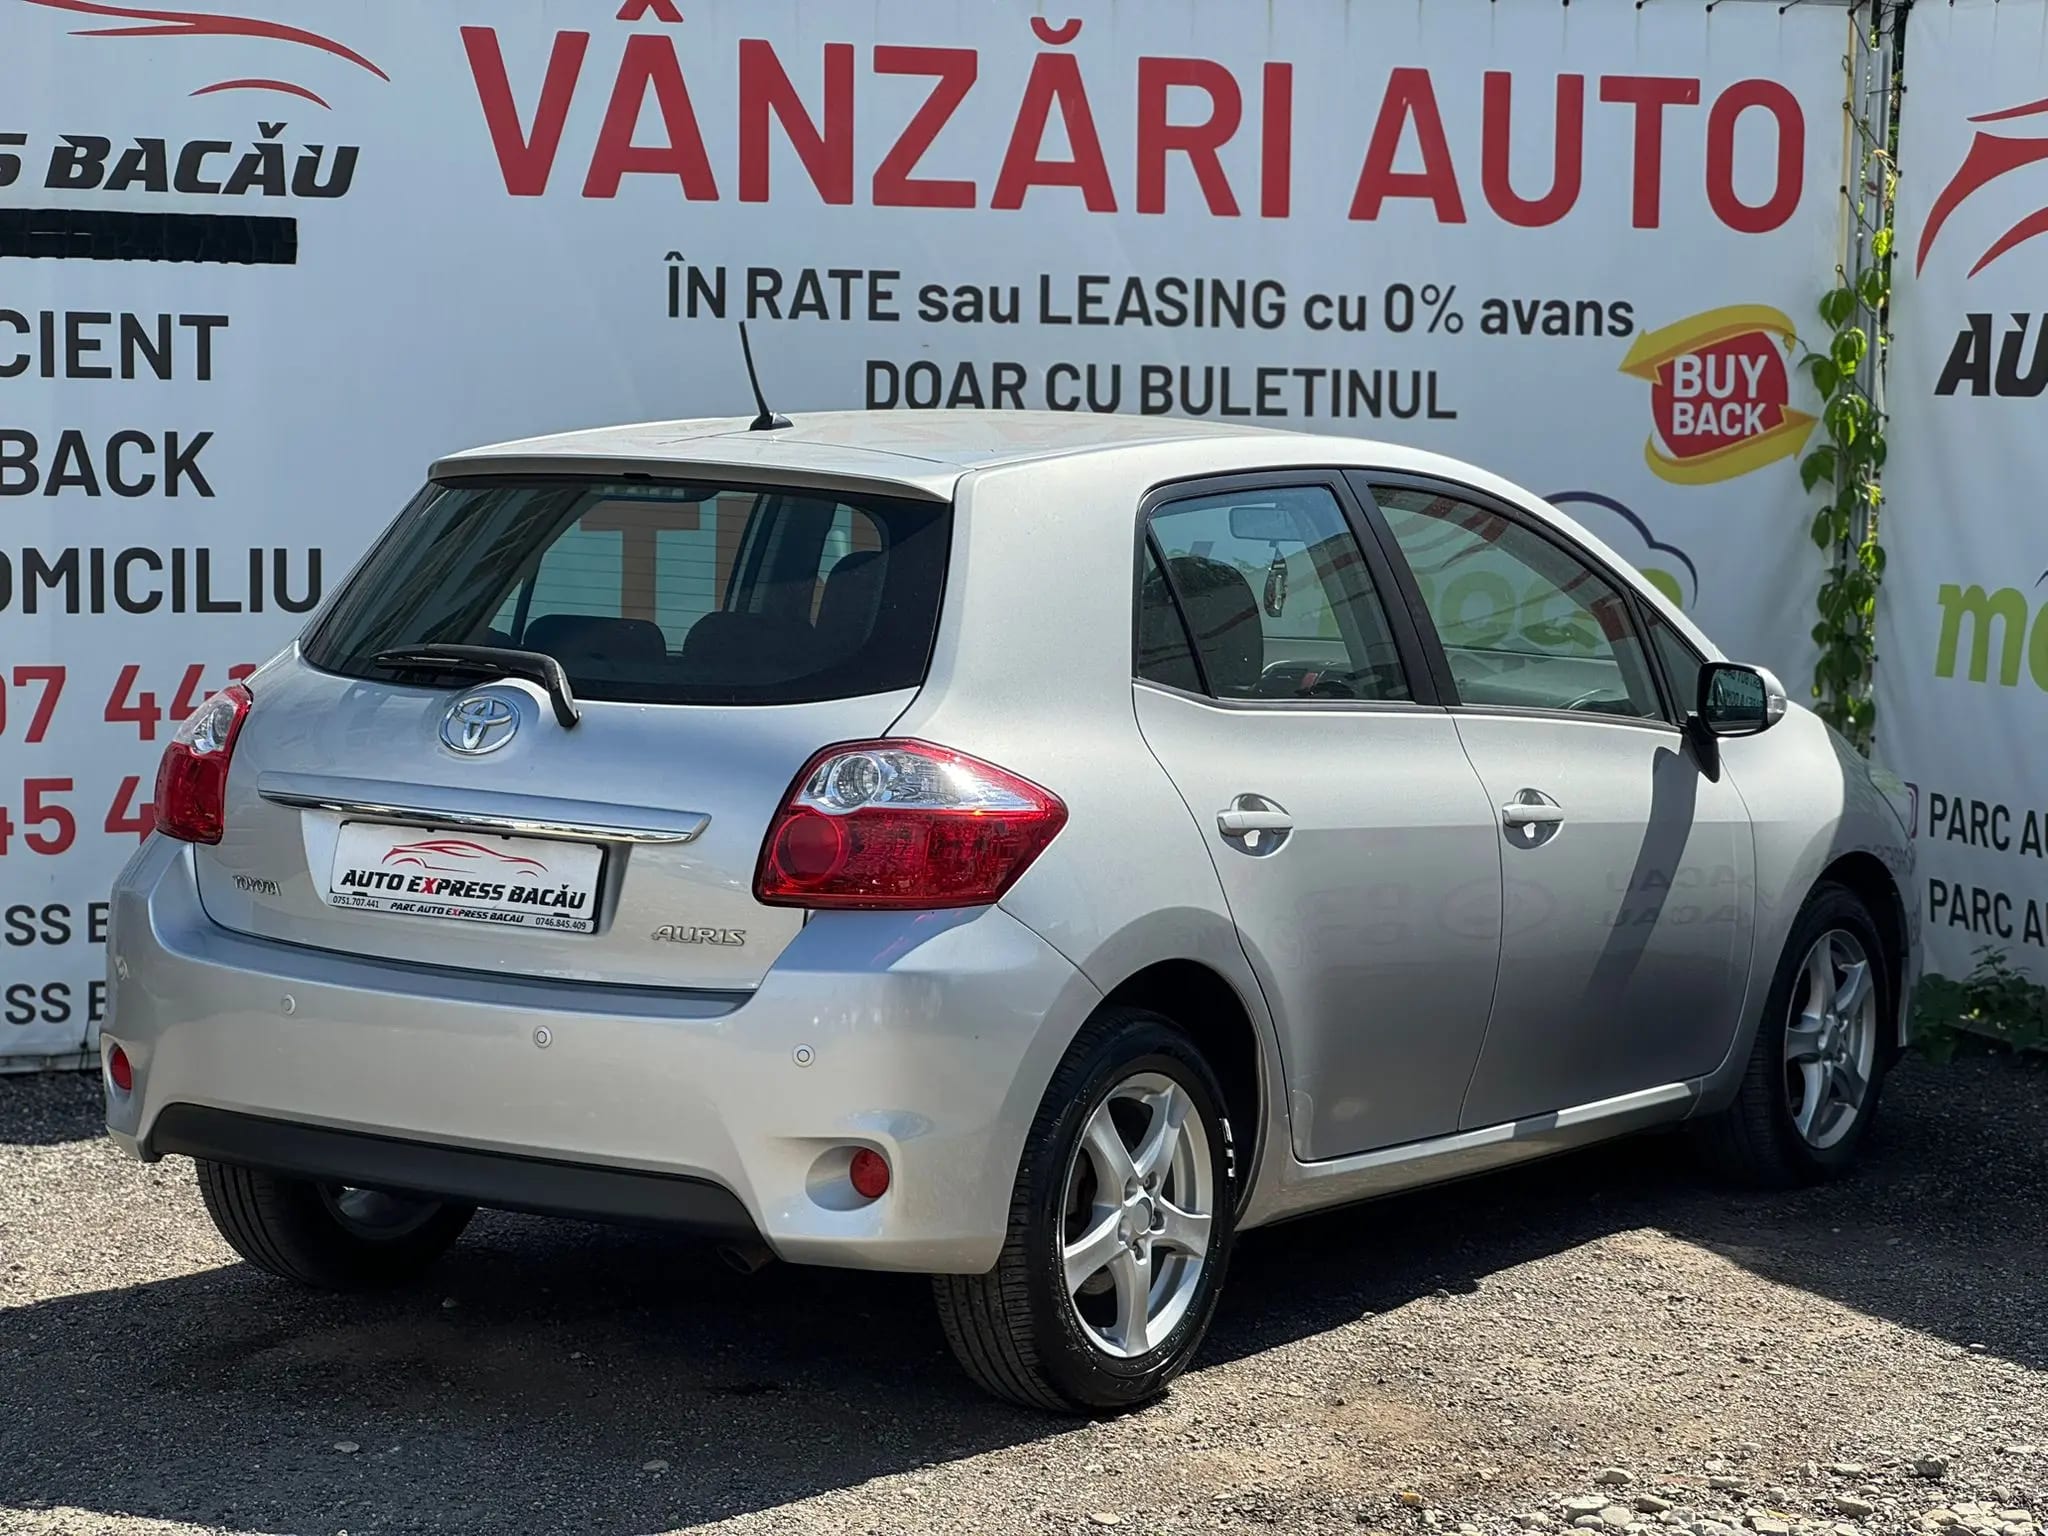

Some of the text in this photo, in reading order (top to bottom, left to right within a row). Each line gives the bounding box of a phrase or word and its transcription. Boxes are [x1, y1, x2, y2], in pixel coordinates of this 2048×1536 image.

[460, 0, 1805, 233] VÂNZĂRI AUTO
[44, 121, 360, 198] BACĂU
[664, 251, 1634, 337] ÎN RATE sau LEASING cu 0% avans
[866, 360, 1457, 420] DOAR CU BULETINUL
[1673, 353, 1768, 400] BUY
[1672, 400, 1766, 437] BACK
[0, 429, 215, 497] BACK
[0, 547, 322, 614] MICILIU
[1929, 793, 2010, 851] PARC
[232, 874, 282, 897] TOYOTA
[333, 895, 379, 908] 0751.707.441
[341, 869, 586, 910] AUTO EXPRESS BACĂU
[1929, 878, 2013, 939] PARC
[390, 902, 524, 923] PARC AUTO EXPRESS BACAU
[535, 917, 587, 930] 0746.845.409
[651, 924, 746, 947] AURIS
